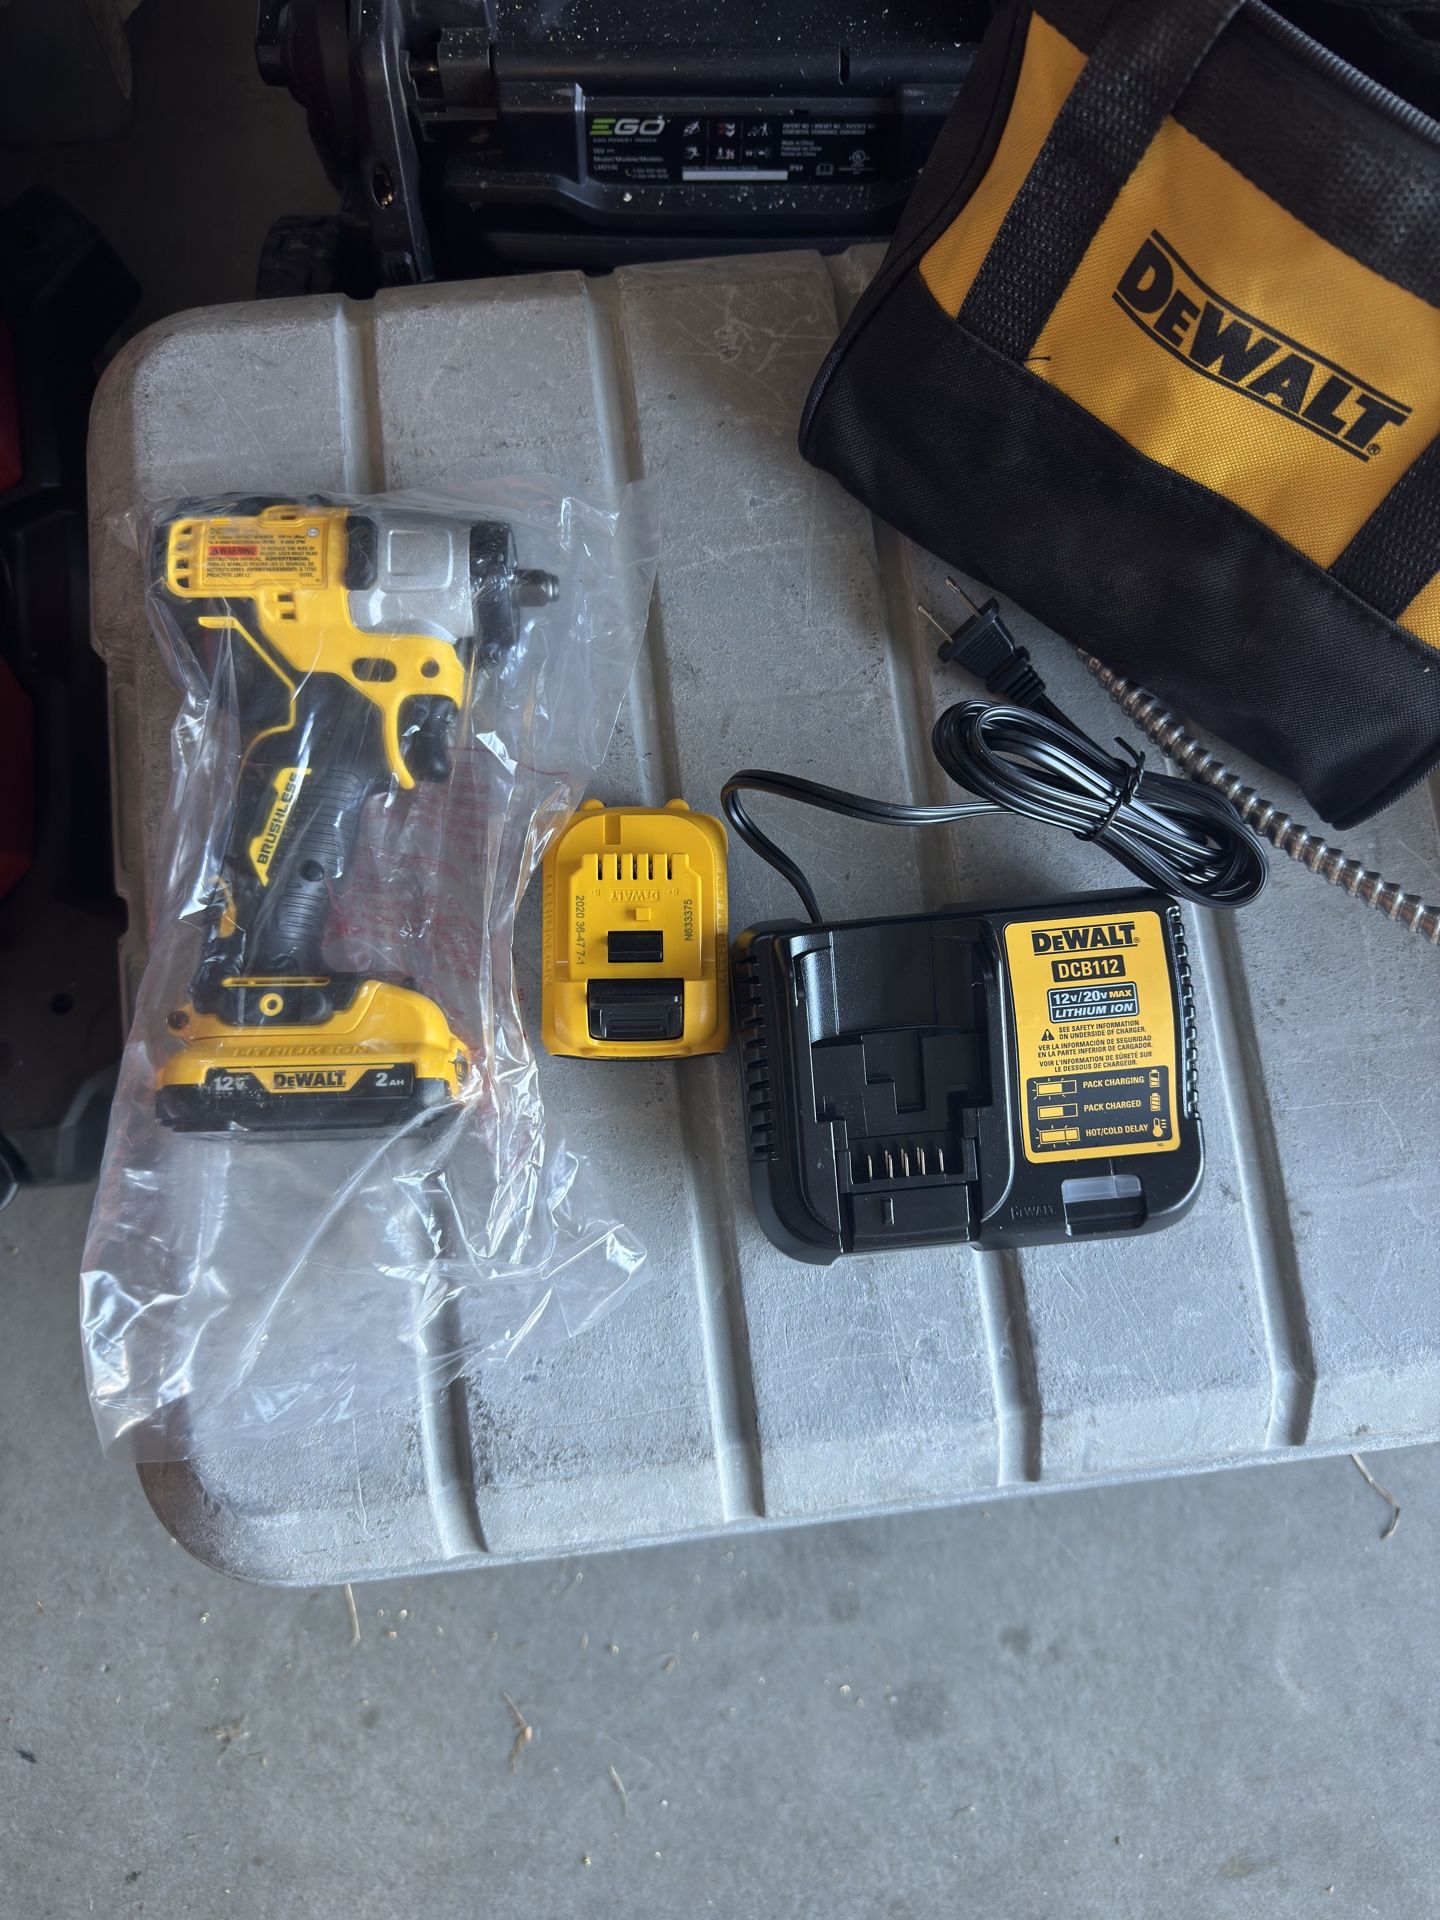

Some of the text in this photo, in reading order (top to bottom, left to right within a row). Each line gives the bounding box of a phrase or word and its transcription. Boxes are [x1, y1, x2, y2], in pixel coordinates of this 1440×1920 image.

[590, 118, 665, 135] EGO
[1114, 234, 1410, 458] DEWALT
[220, 546, 256, 556] WARNING
[257, 771, 299, 865] BRUSHLESS
[575, 895, 585, 919] 2020
[683, 899, 693, 942] N633375
[1031, 921, 1138, 956] DEWALT
[1057, 958, 1120, 979] DCB112
[1108, 988, 1133, 999] MAX
[1055, 1002, 1134, 1019] LITHIUM ION
[1069, 1030, 1106, 1040] UNDERSIDE
[1115, 1026, 1147, 1035] CHARGER.
[1071, 1023, 1095, 1033] SAFETY
[1095, 1019, 1140, 1030] INFORMATION
[1038, 1044, 1051, 1052] VER
[1060, 1039, 1105, 1049] INFORMACIÓN
[1116, 1034, 1152, 1044] SEGURIDAD
[1038, 1051, 1047, 1059] EN
[1047, 1050, 1056, 1058] LA
[1057, 1048, 1077, 1057] PARTE
[1077, 1046, 1107, 1055] INFERIOR
[1117, 1041, 1153, 1051] CARGADOR.
[1039, 1059, 1055, 1067] VOIR
[1055, 1055, 1104, 1066] L'INFORMATION
[1115, 1051, 1138, 1060] SÛRETÉ
[1054, 1065, 1062, 1073] LE
[1063, 1063, 1092, 1072] DESSOUS
[1102, 1059, 1138, 1068] CHARGEUR.
[213, 1075, 246, 1091] 12V
[273, 1071, 347, 1089] DEWALT
[1082, 1075, 1145, 1089] PACK CHARGING
[1083, 1099, 1142, 1112] PACK CHARGED
[1085, 1123, 1149, 1137] HOT/COLD DELAY
